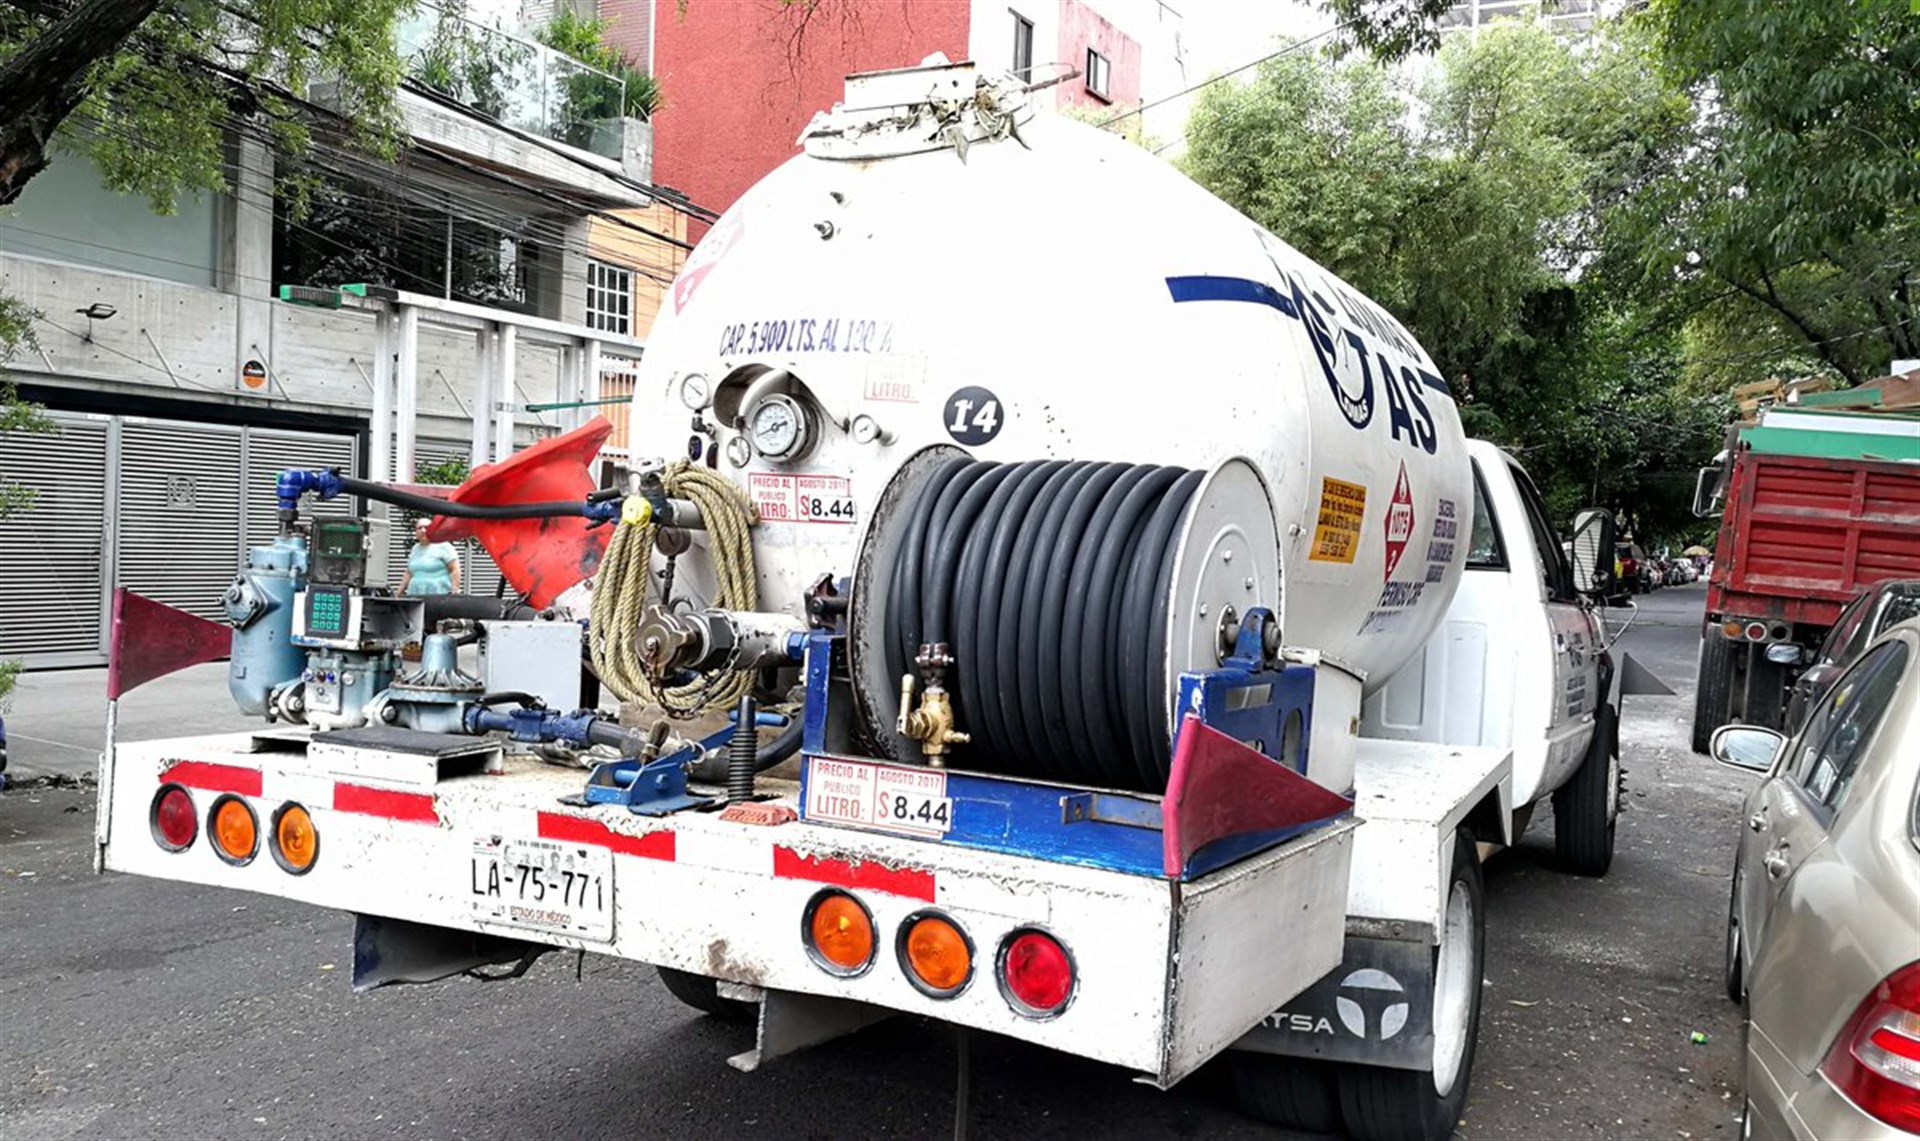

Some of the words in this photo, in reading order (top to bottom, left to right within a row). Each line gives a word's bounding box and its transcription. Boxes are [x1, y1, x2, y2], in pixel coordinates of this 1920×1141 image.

[719, 323, 746, 357] CAP.
[819, 318, 840, 352] AL
[950, 399, 998, 433] 14
[753, 477, 780, 488] PRECIO
[782, 479, 791, 488] AL
[800, 479, 827, 489] AGOSTO
[1391, 510, 1409, 535] 1075
[817, 762, 853, 779] PRECIO
[857, 767, 868, 781] AL
[880, 770, 914, 786] AGOSTO
[918, 775, 940, 788] 2017
[816, 794, 865, 820] LITRO:
[472, 857, 602, 912] LA-75-771
[510, 905, 534, 920] ESTADO
[536, 909, 546, 920] DE
[1262, 1012, 1334, 1035] TSA
